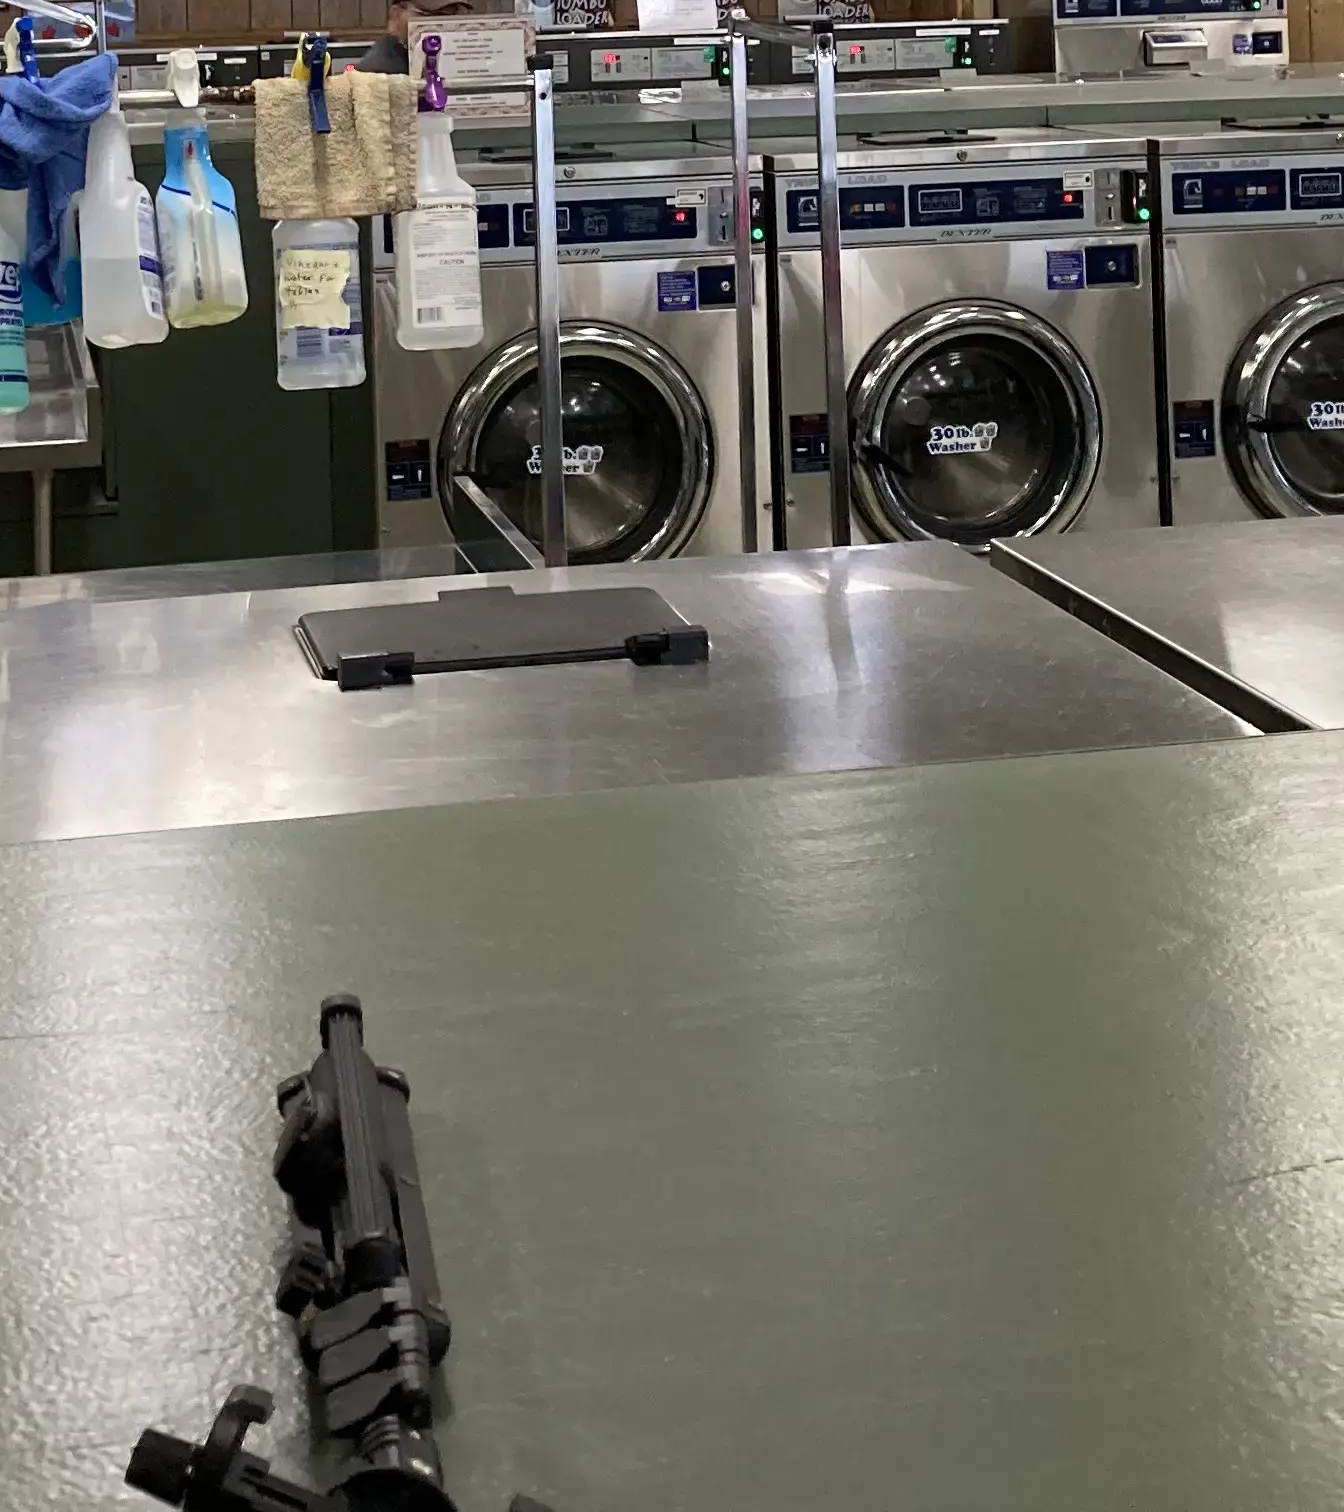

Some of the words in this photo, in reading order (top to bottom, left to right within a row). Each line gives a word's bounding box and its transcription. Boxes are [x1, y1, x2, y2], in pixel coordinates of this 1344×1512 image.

[556, 10, 609, 26] LOADER
[818, 4, 869, 19] LOADER
[1313, 403, 1334, 417] 30
[932, 427, 954, 441] 30
[956, 427, 973, 438] lb.
[928, 441, 977, 452] Washer
